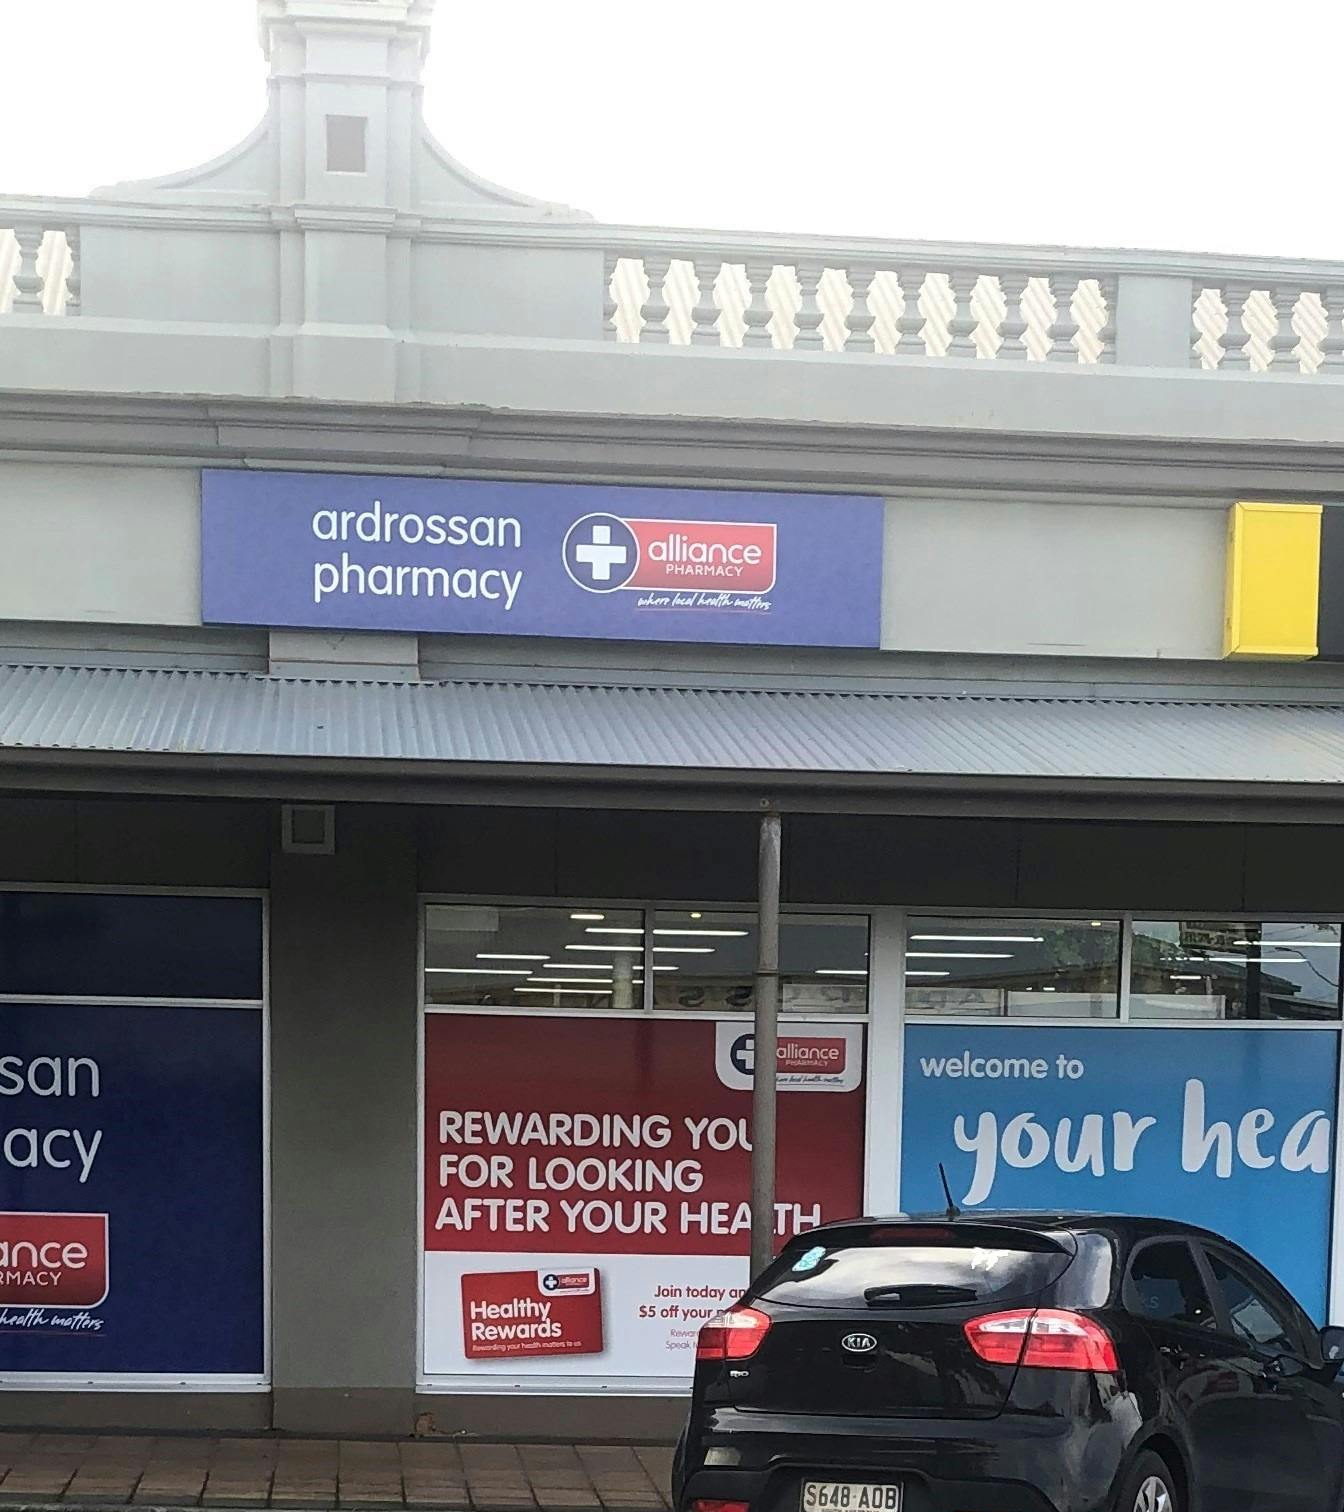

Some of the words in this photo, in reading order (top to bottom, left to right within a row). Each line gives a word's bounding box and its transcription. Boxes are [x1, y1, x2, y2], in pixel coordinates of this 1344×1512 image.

[312, 500, 522, 549] ardrossan
[648, 533, 762, 564] alliance
[313, 552, 523, 610] pharmacy
[666, 564, 744, 577] PHARMACY
[638, 592, 668, 606] where
[672, 593, 695, 606] local
[697, 592, 733, 606] health
[734, 596, 771, 610] matters
[776, 1043, 840, 1060] alliance
[920, 1051, 1050, 1080] welcome
[1058, 1054, 1084, 1080] to
[439, 1111, 671, 1148] REWARDING
[954, 1111, 1157, 1206] your
[439, 1154, 514, 1189] FOR
[529, 1157, 703, 1193] LOOKING
[435, 1198, 549, 1232] AFTER
[560, 1200, 667, 1234] YOUR
[681, 1202, 821, 1236] HEATH
[654, 1285, 682, 1298] Join
[686, 1285, 726, 1302] today
[729, 1288, 747, 1298] an
[470, 1298, 551, 1321] Healthy
[639, 1305, 656, 1318] $5
[661, 1305, 679, 1318] off
[682, 1309, 714, 1321] your
[51, 1312, 105, 1331] matters
[471, 1318, 562, 1341] Rewards
[847, 1337, 871, 1348] KIA
